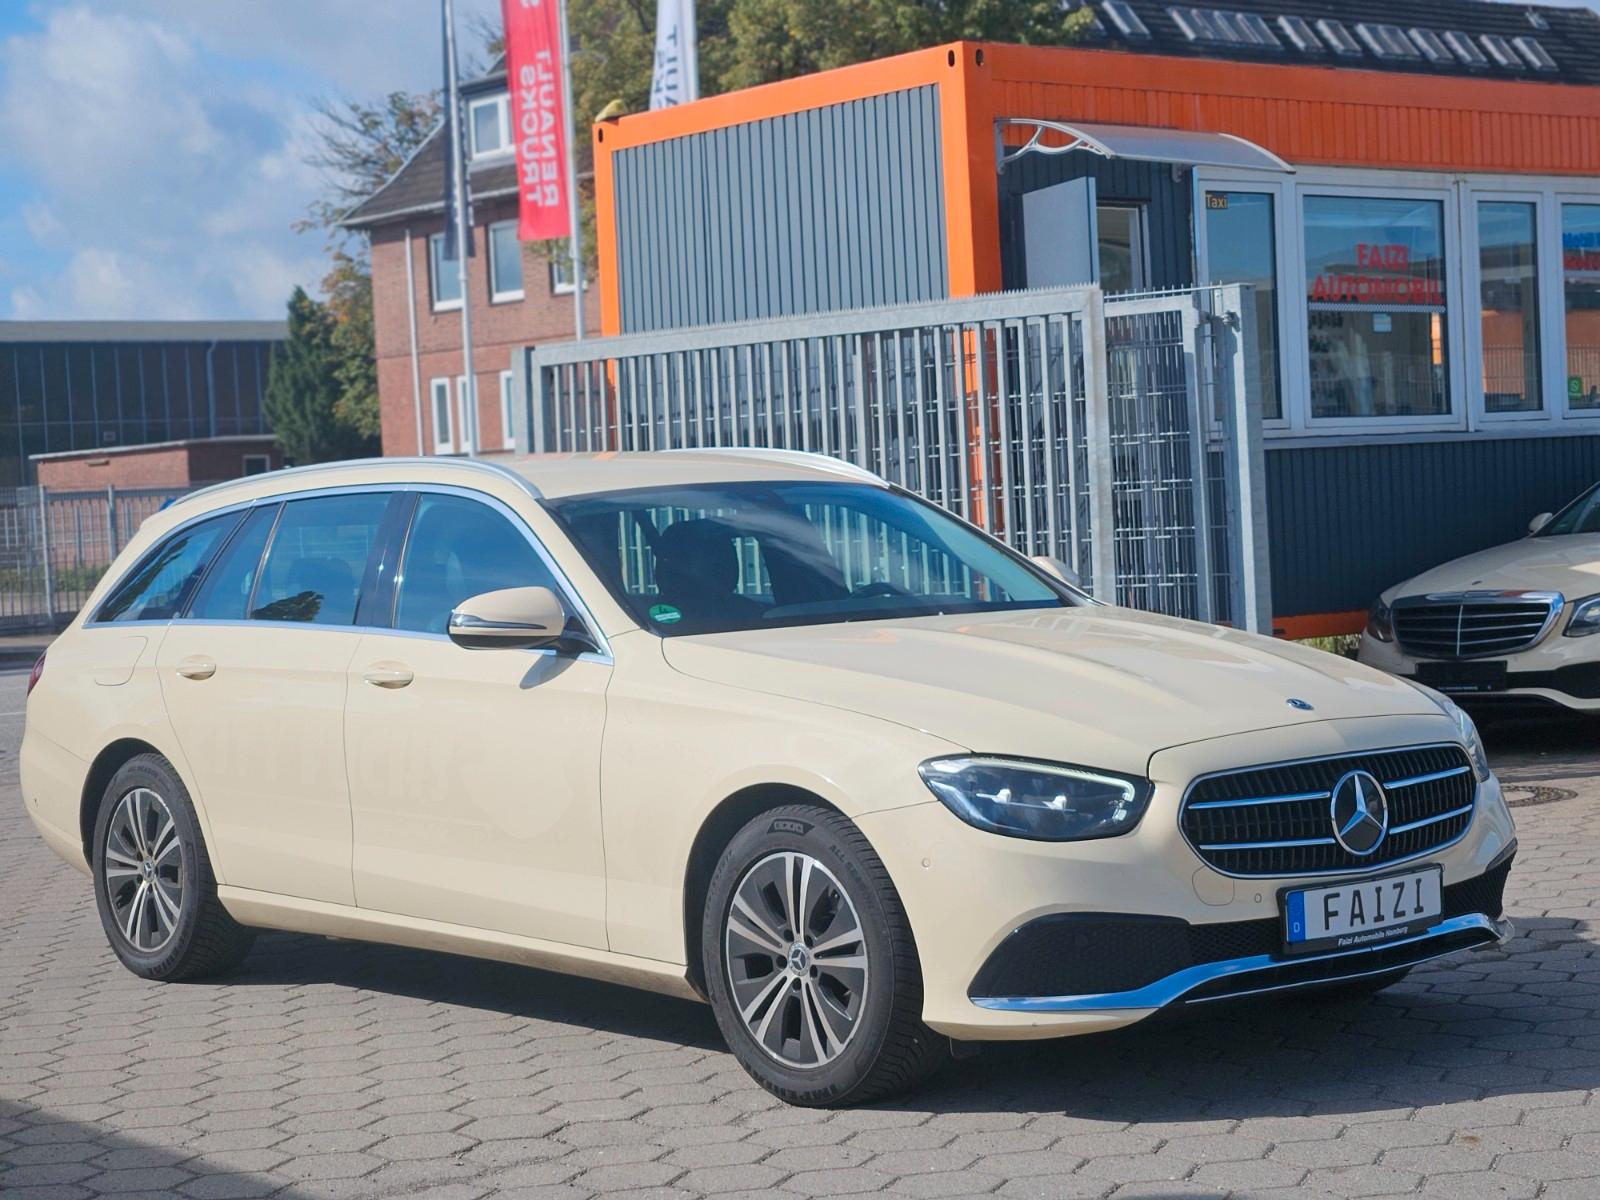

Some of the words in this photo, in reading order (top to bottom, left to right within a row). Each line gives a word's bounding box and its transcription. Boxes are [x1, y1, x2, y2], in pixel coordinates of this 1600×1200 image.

[1206, 194, 1228, 209] Taxi
[1356, 243, 1409, 272] FAIZI
[1311, 274, 1444, 305] AUTOMOBIL
[1322, 878, 1425, 931] FAIZI
